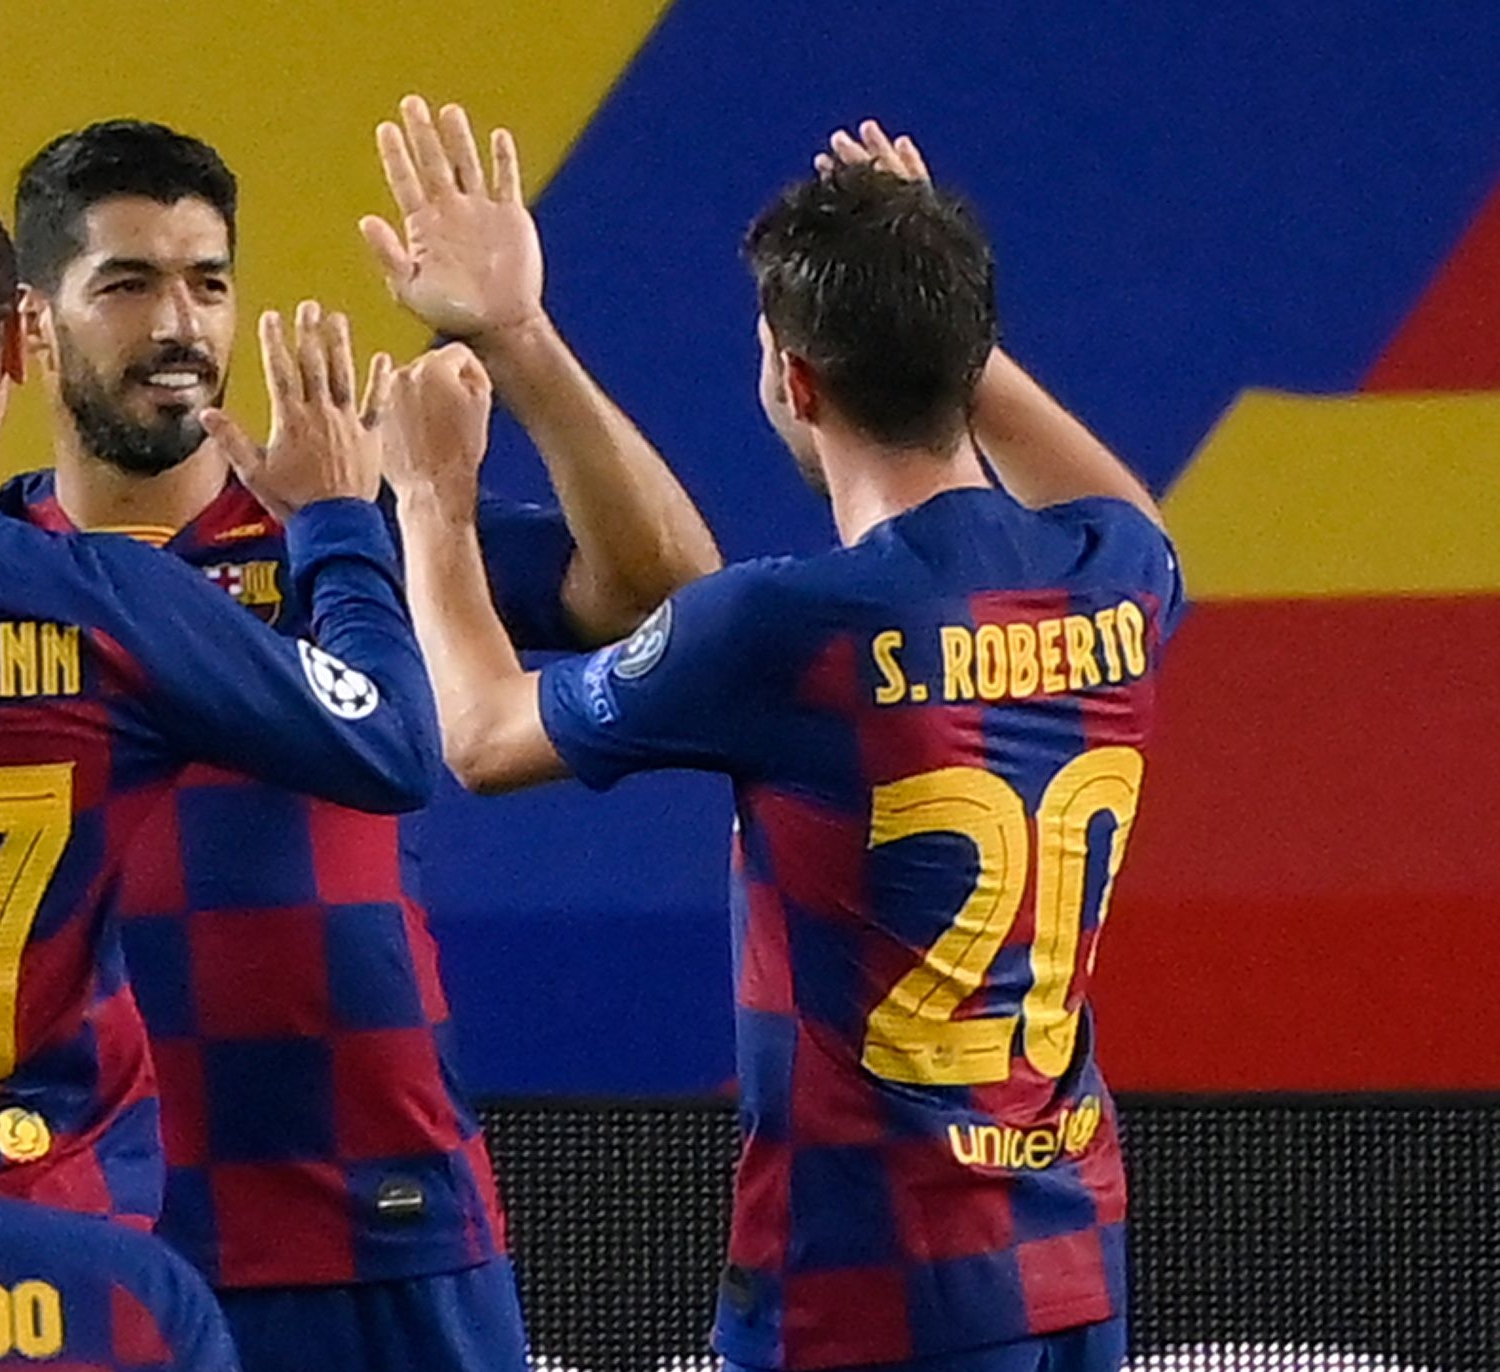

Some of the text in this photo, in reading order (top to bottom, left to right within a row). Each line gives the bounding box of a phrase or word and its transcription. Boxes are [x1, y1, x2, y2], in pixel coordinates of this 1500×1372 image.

[872, 600, 1146, 705] S. ROBERTO
[861, 746, 1144, 1086] 20
